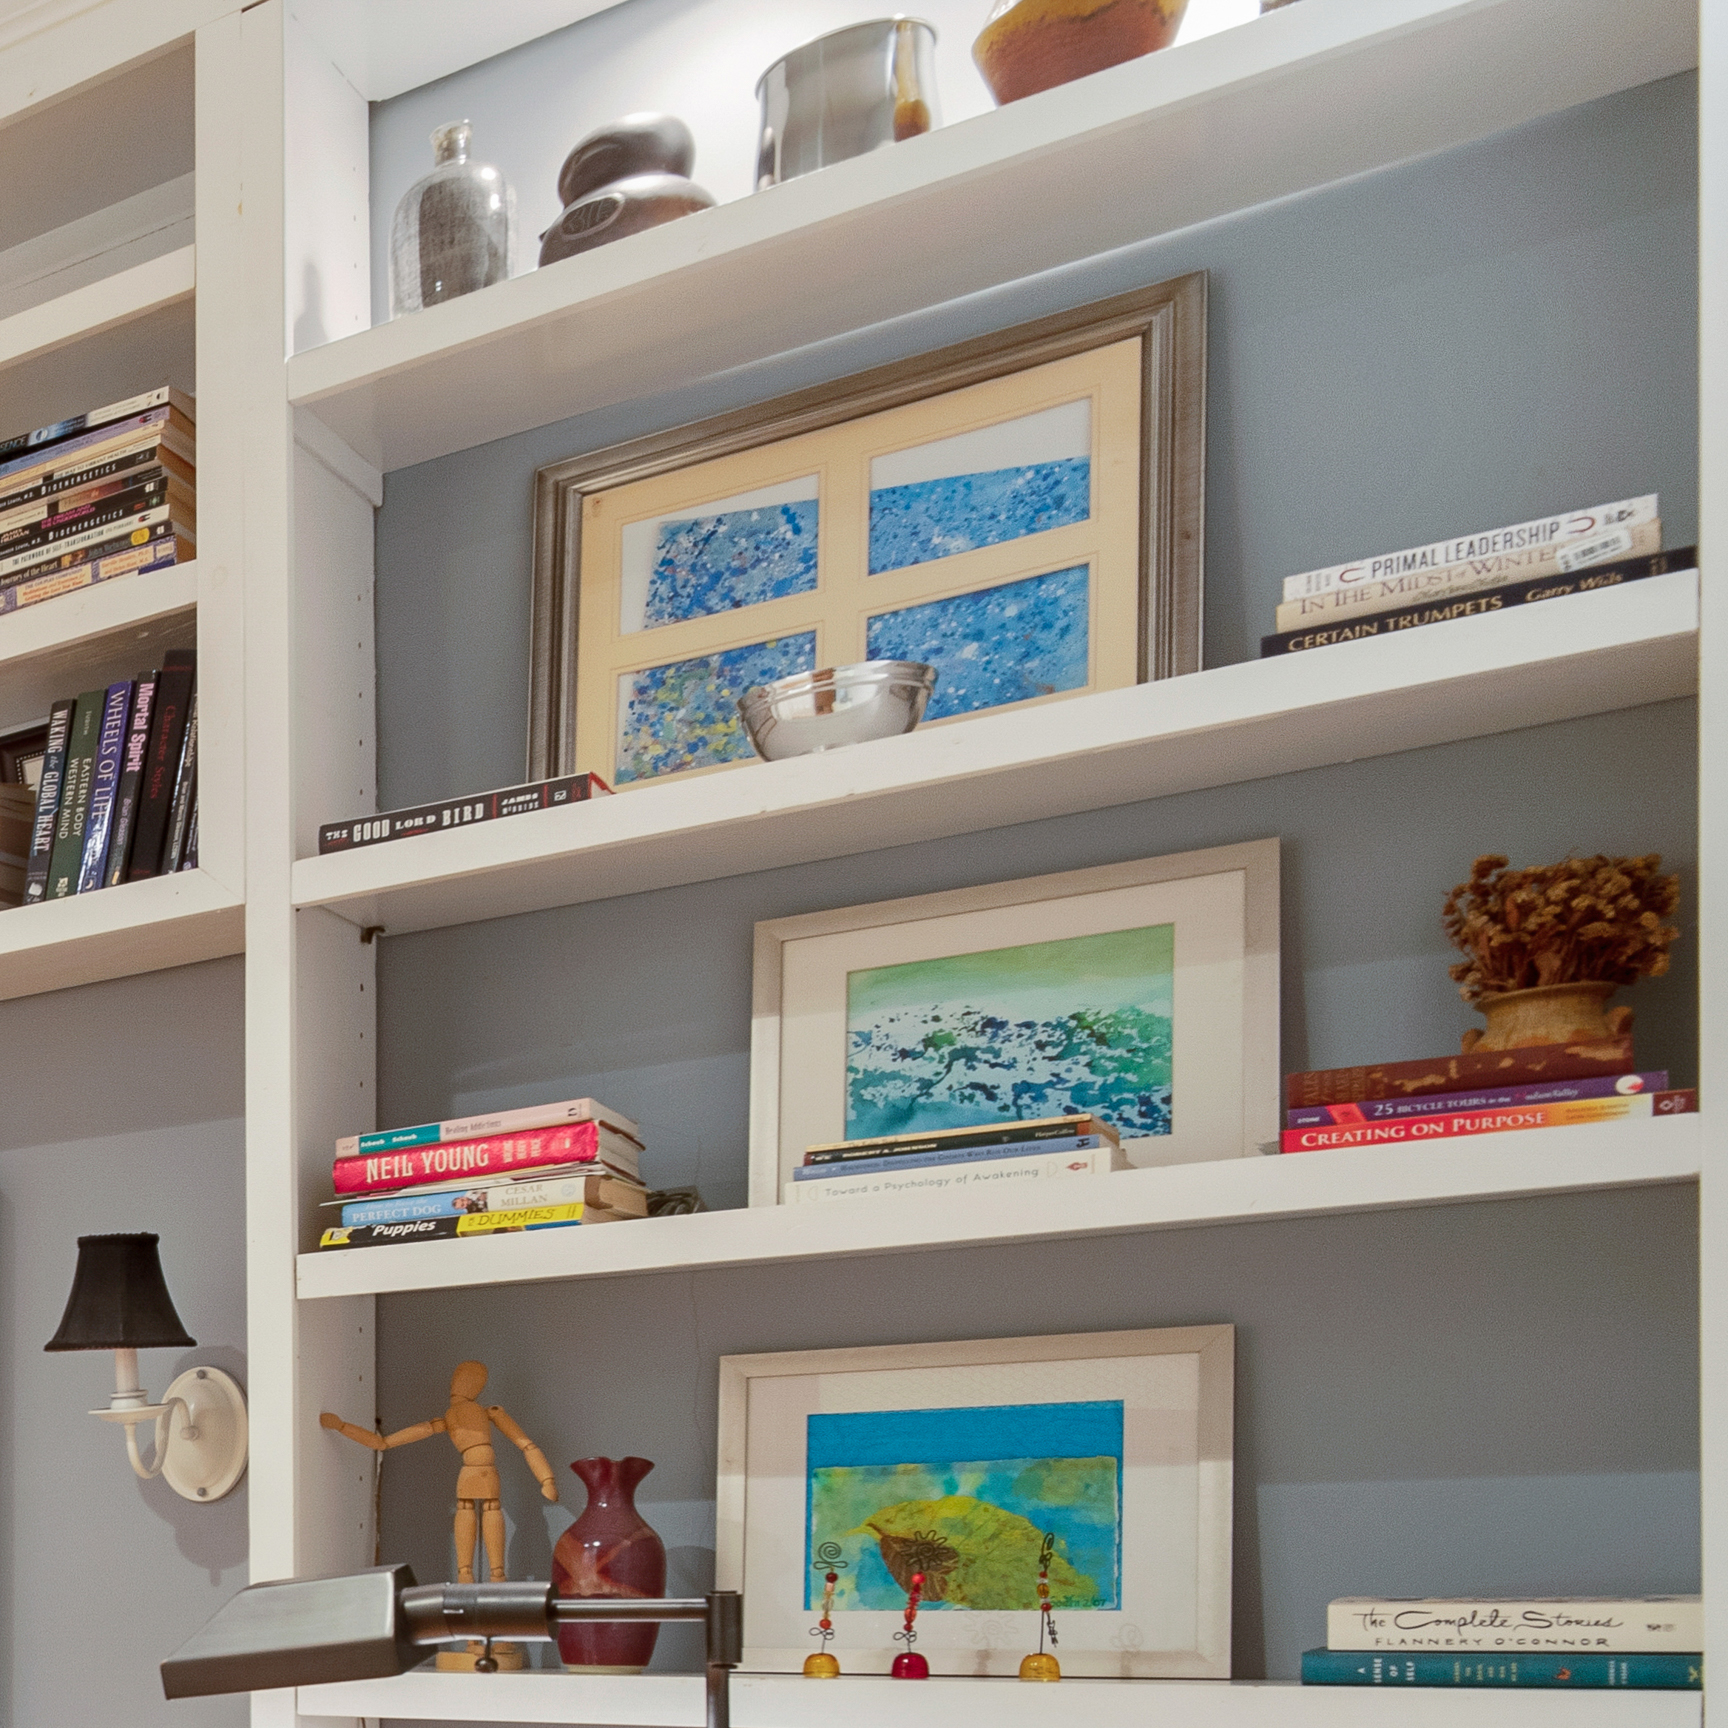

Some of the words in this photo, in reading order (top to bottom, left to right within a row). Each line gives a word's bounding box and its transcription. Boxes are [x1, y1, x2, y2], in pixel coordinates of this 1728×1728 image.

[1372, 548, 1439, 579] PRIMAL
[1444, 521, 1559, 563] LEADERSHIP
[1300, 597, 1326, 615] IN
[1334, 586, 1373, 608] THE
[1380, 571, 1453, 600] MIDST
[1288, 621, 1378, 652] CERTAIN
[1387, 595, 1503, 632] TRUMPETS
[1525, 582, 1575, 603] Garry
[101, 689, 125, 755] WHEELS
[132, 682, 155, 731] Mortal
[47, 709, 68, 755] WAKING
[50, 755, 59, 770] the
[126, 732, 146, 773] Spirit
[61, 758, 79, 805] WESTERN
[76, 758, 91, 802] EASTERN
[97, 758, 115, 781] OF
[38, 771, 59, 812] GLOBAL
[90, 785, 111, 820] LIFE
[502, 792, 538, 806] JAMES
[34, 814, 53, 851] HEART
[59, 808, 72, 839] MIND
[73, 806, 84, 837] BODY
[325, 829, 348, 840] THE
[353, 819, 390, 842] GOOD
[395, 814, 436, 830] LORD
[442, 803, 484, 826] BIRD
[1372, 1103, 1394, 1117] 25
[1396, 1102, 1445, 1115] BICYCLE
[1446, 1097, 1487, 1110] TOURS
[1301, 1123, 1405, 1148] CREATING
[1411, 1120, 1444, 1137] ON
[1452, 1111, 1545, 1132] PURPOSE
[366, 1154, 413, 1183] NEIL
[420, 1143, 489, 1173] YOUNG
[505, 1184, 543, 1195] CESAR
[825, 1185, 869, 1197] Toward
[873, 1184, 880, 1193] a
[884, 1174, 954, 1192] Psychology
[956, 1174, 968, 1184] of
[972, 1167, 1040, 1182] Awakening
[352, 1206, 409, 1222] PERFECT
[412, 1204, 442, 1215] DOG
[500, 1194, 548, 1207] MILLAN
[372, 1221, 436, 1237] Puppies
[478, 1208, 555, 1227] DUMMIES
[1352, 1607, 1387, 1629] The
[1394, 1609, 1512, 1636] Complete
[1512, 1610, 1625, 1630] Stories
[1375, 1637, 1482, 1647] FLANNERY
[1495, 1637, 1610, 1647] O'CONNOR
[1373, 1658, 1383, 1682] SENSE
[1389, 1665, 1398, 1677] OF
[1405, 1662, 1415, 1682] SELF
